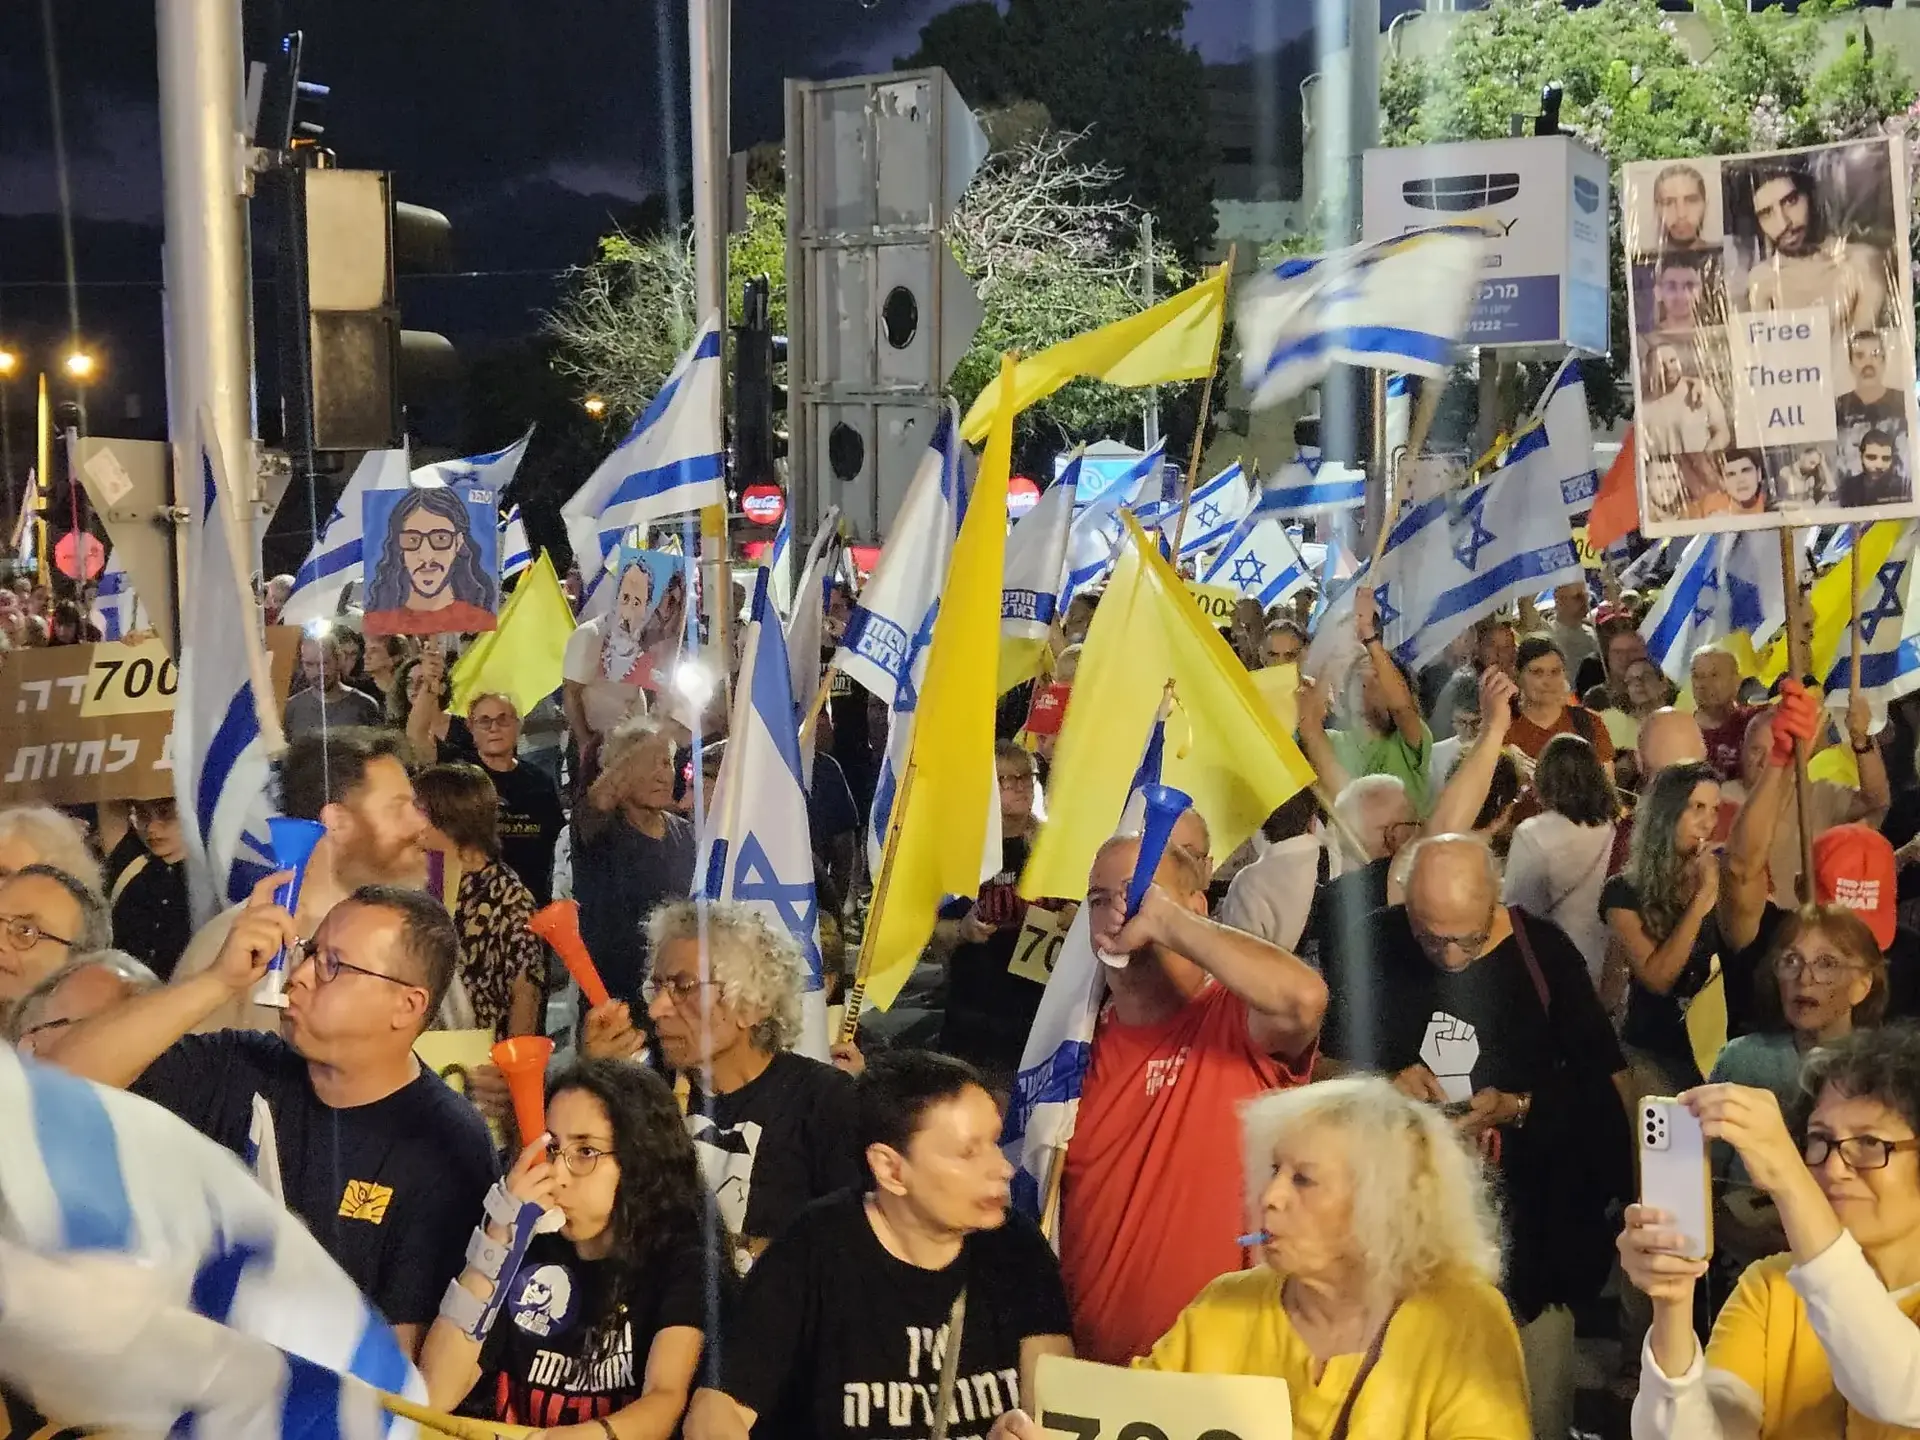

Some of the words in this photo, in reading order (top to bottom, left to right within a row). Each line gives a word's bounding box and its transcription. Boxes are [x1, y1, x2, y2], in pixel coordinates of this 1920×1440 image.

[1749, 320, 1811, 344] Free
[1744, 365, 1821, 387] Them
[1768, 405, 1806, 428] All
[93, 658, 178, 701] 700
[4, 733, 141, 783] לחיות
[1020, 924, 1065, 973] 70
